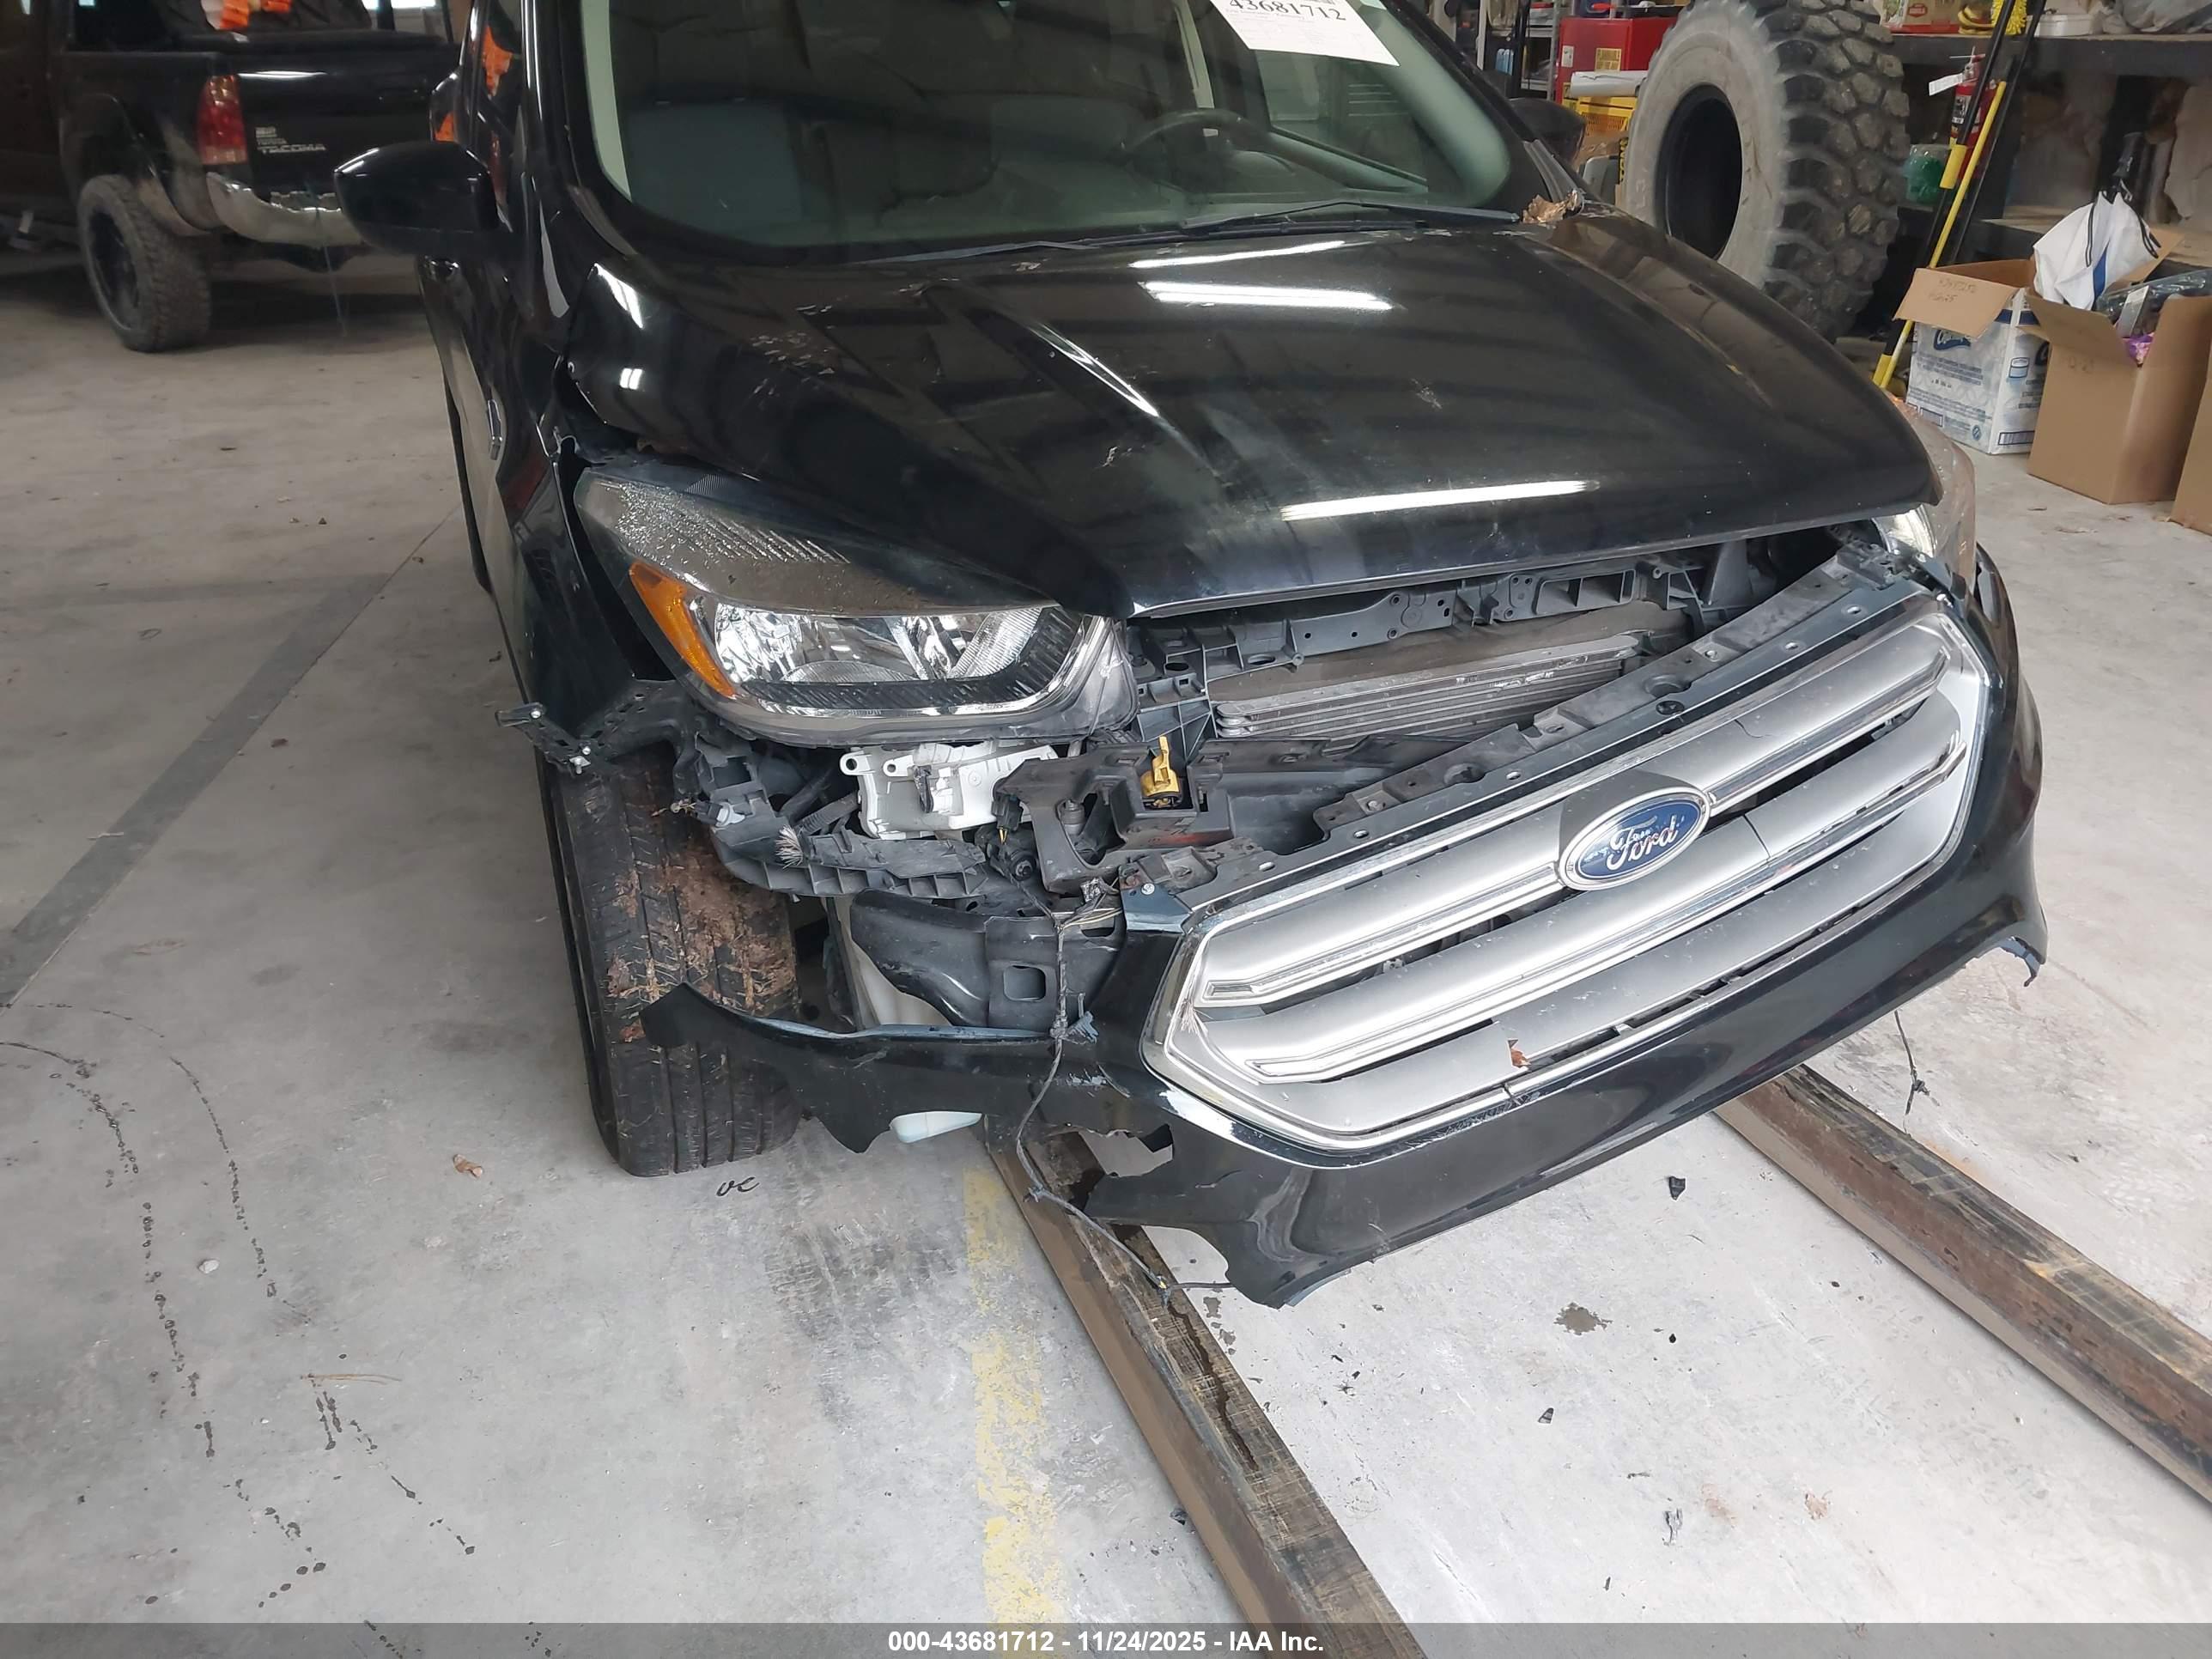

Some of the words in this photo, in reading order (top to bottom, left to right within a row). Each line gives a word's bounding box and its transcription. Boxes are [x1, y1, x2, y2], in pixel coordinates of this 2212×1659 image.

[1230, 0, 1346, 21] 43681712
[257, 143, 326, 155] TACOMA
[1606, 815, 1679, 871] Ford
